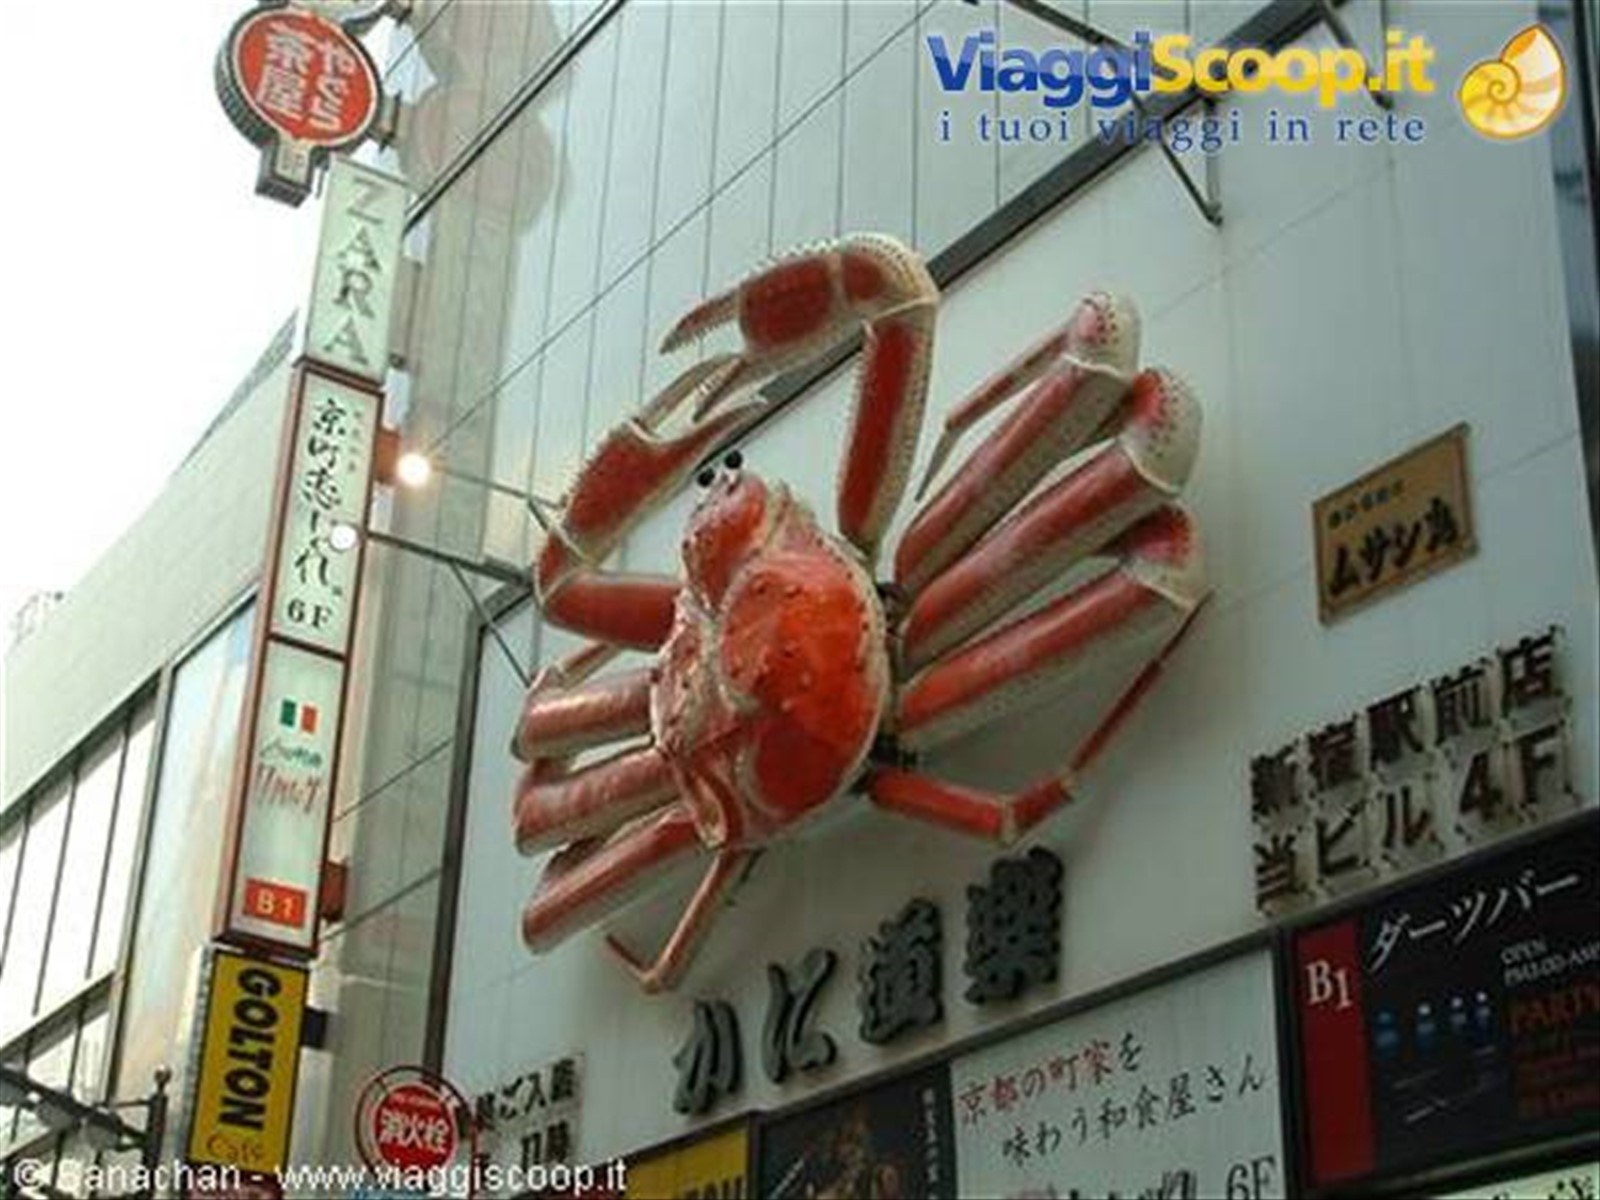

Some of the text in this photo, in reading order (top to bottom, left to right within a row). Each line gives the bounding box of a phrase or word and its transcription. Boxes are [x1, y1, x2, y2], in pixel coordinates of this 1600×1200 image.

[323, 177, 384, 366] ZARA
[287, 599, 333, 628] 6F
[256, 889, 294, 918] B1
[1367, 868, 1579, 973] ダーツバー
[1307, 959, 1352, 1011] B1
[218, 967, 282, 1131] GOLTON
[958, 1031, 1144, 1127] 京都の町家を
[380, 1108, 449, 1154] 消火栓
[1002, 1053, 1265, 1168] 味わう和食屋さん
